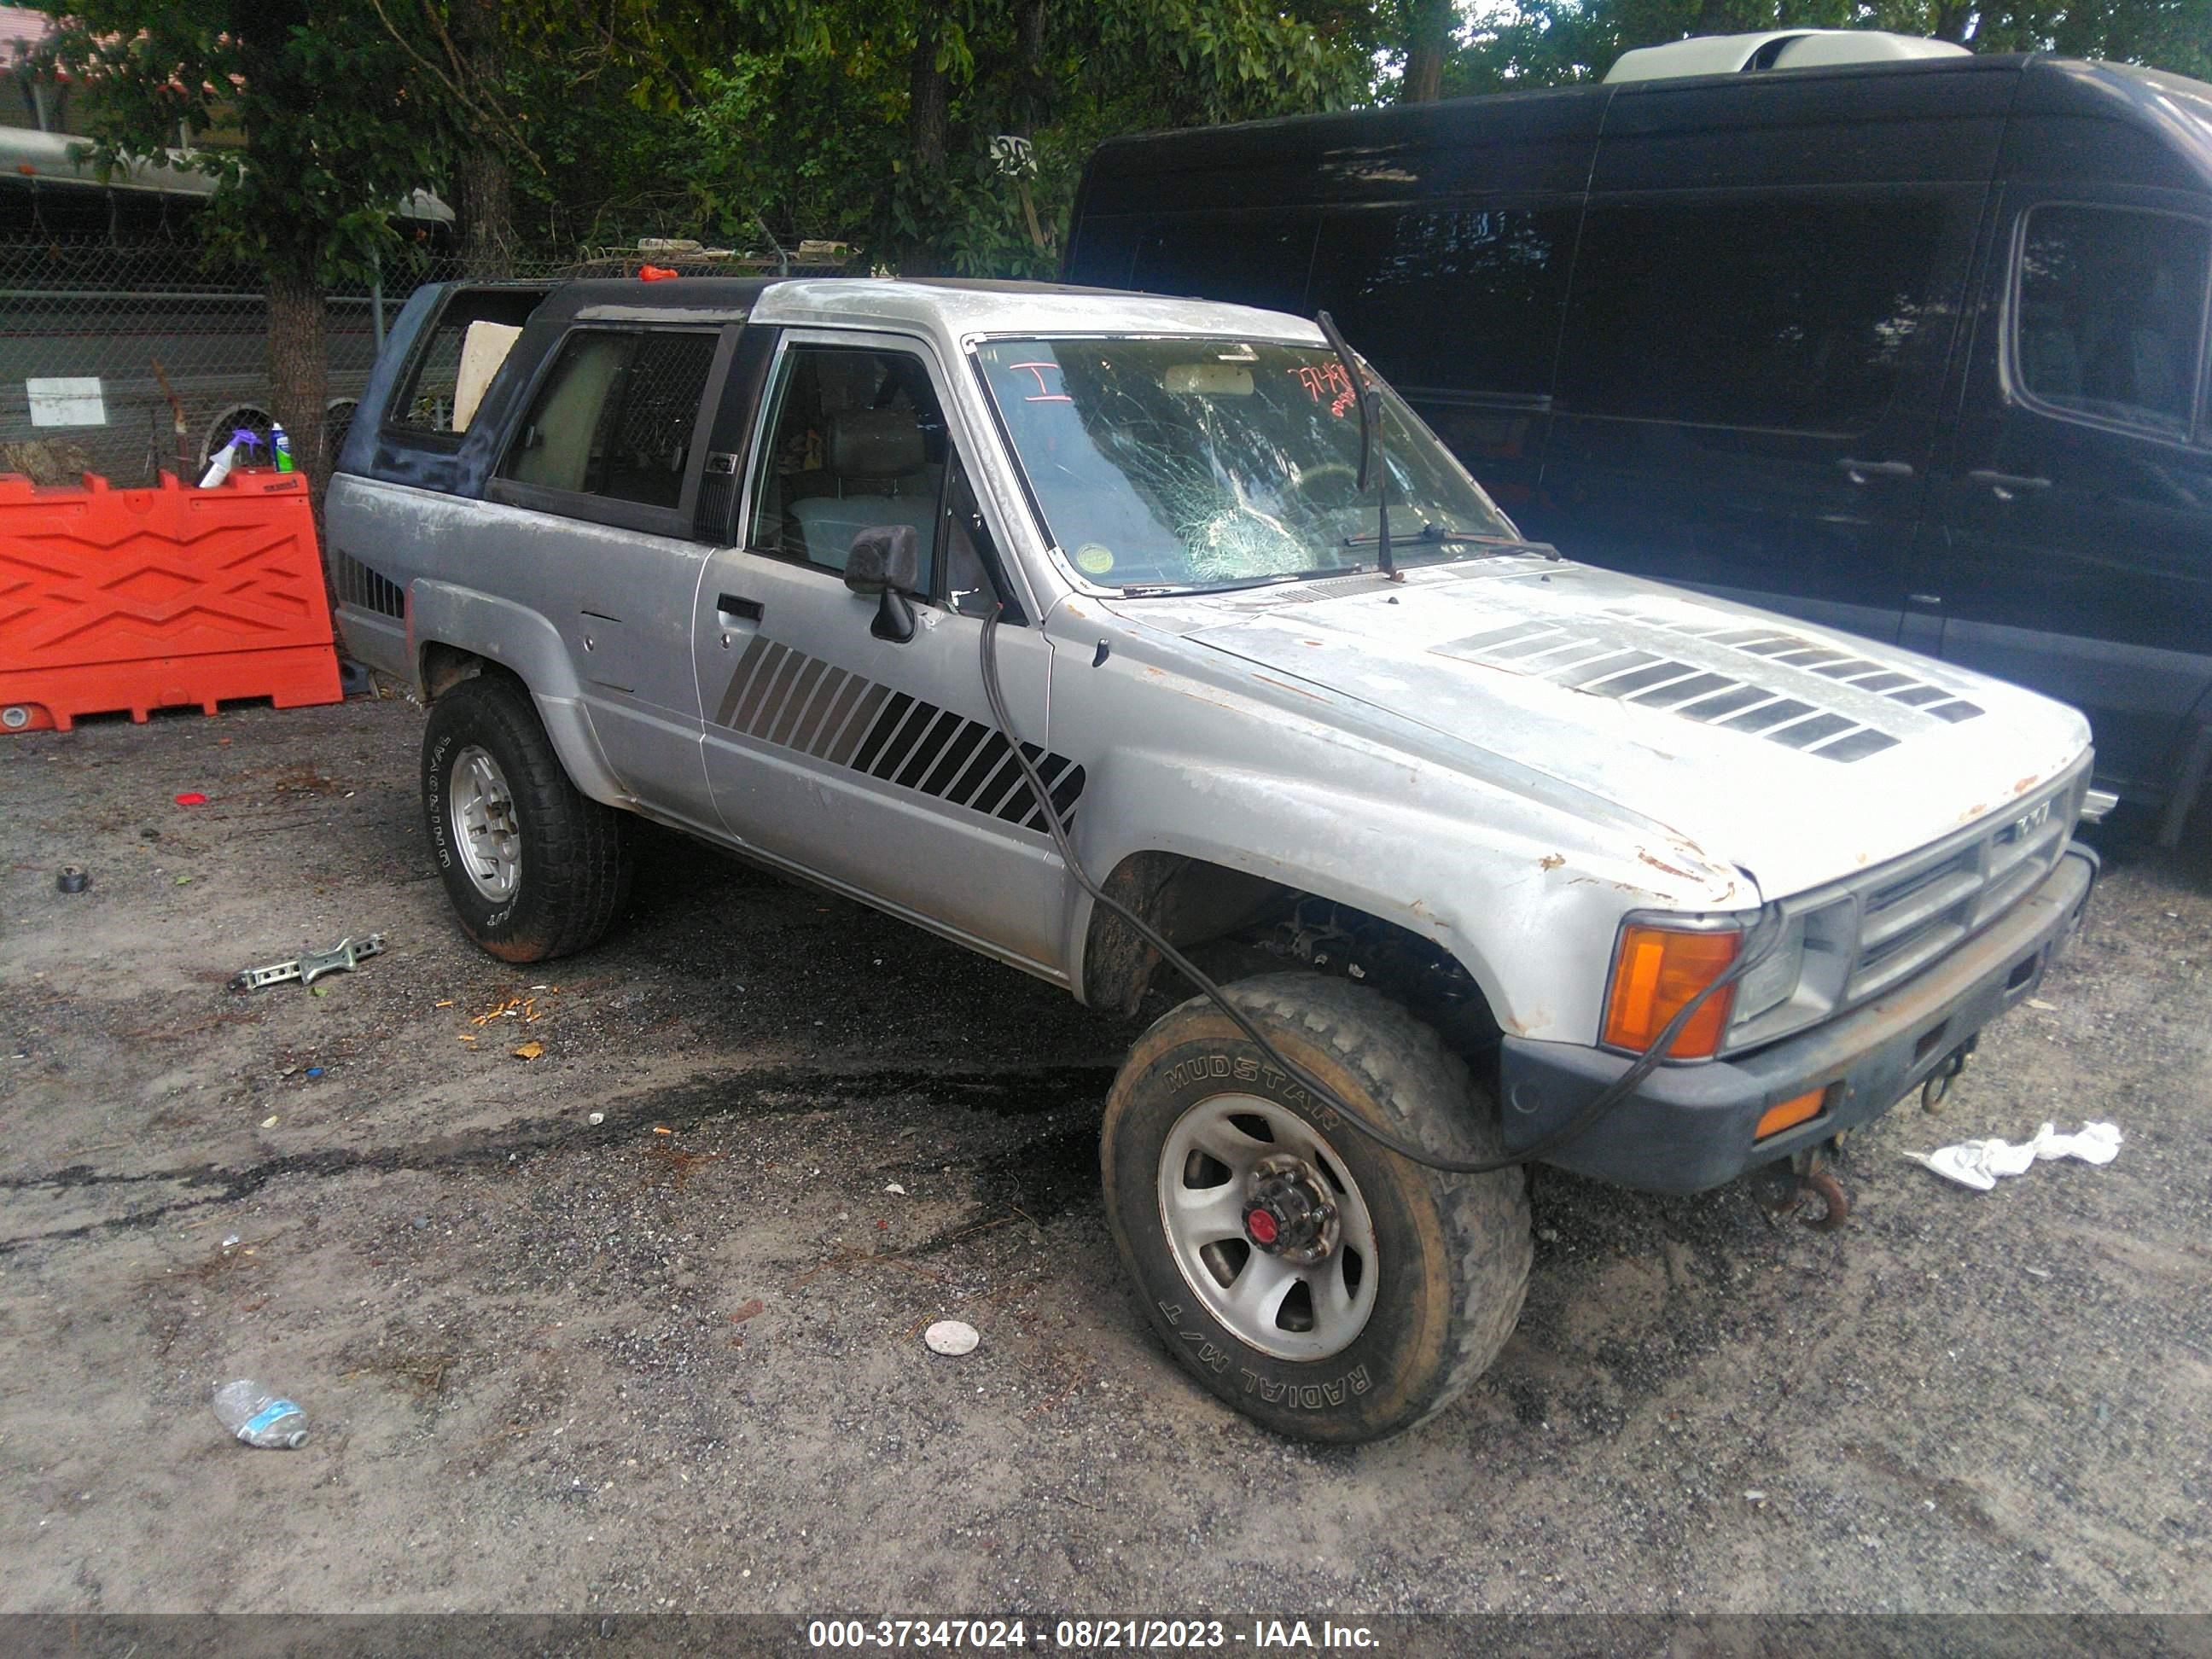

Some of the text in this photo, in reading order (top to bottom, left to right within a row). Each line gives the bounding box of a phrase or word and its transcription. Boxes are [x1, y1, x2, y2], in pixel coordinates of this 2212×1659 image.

[429, 736, 451, 868] UNIROYAL
[1163, 1055, 1341, 1132] MUDSTAR
[1158, 1301, 1372, 1409] RADIAL M/T
